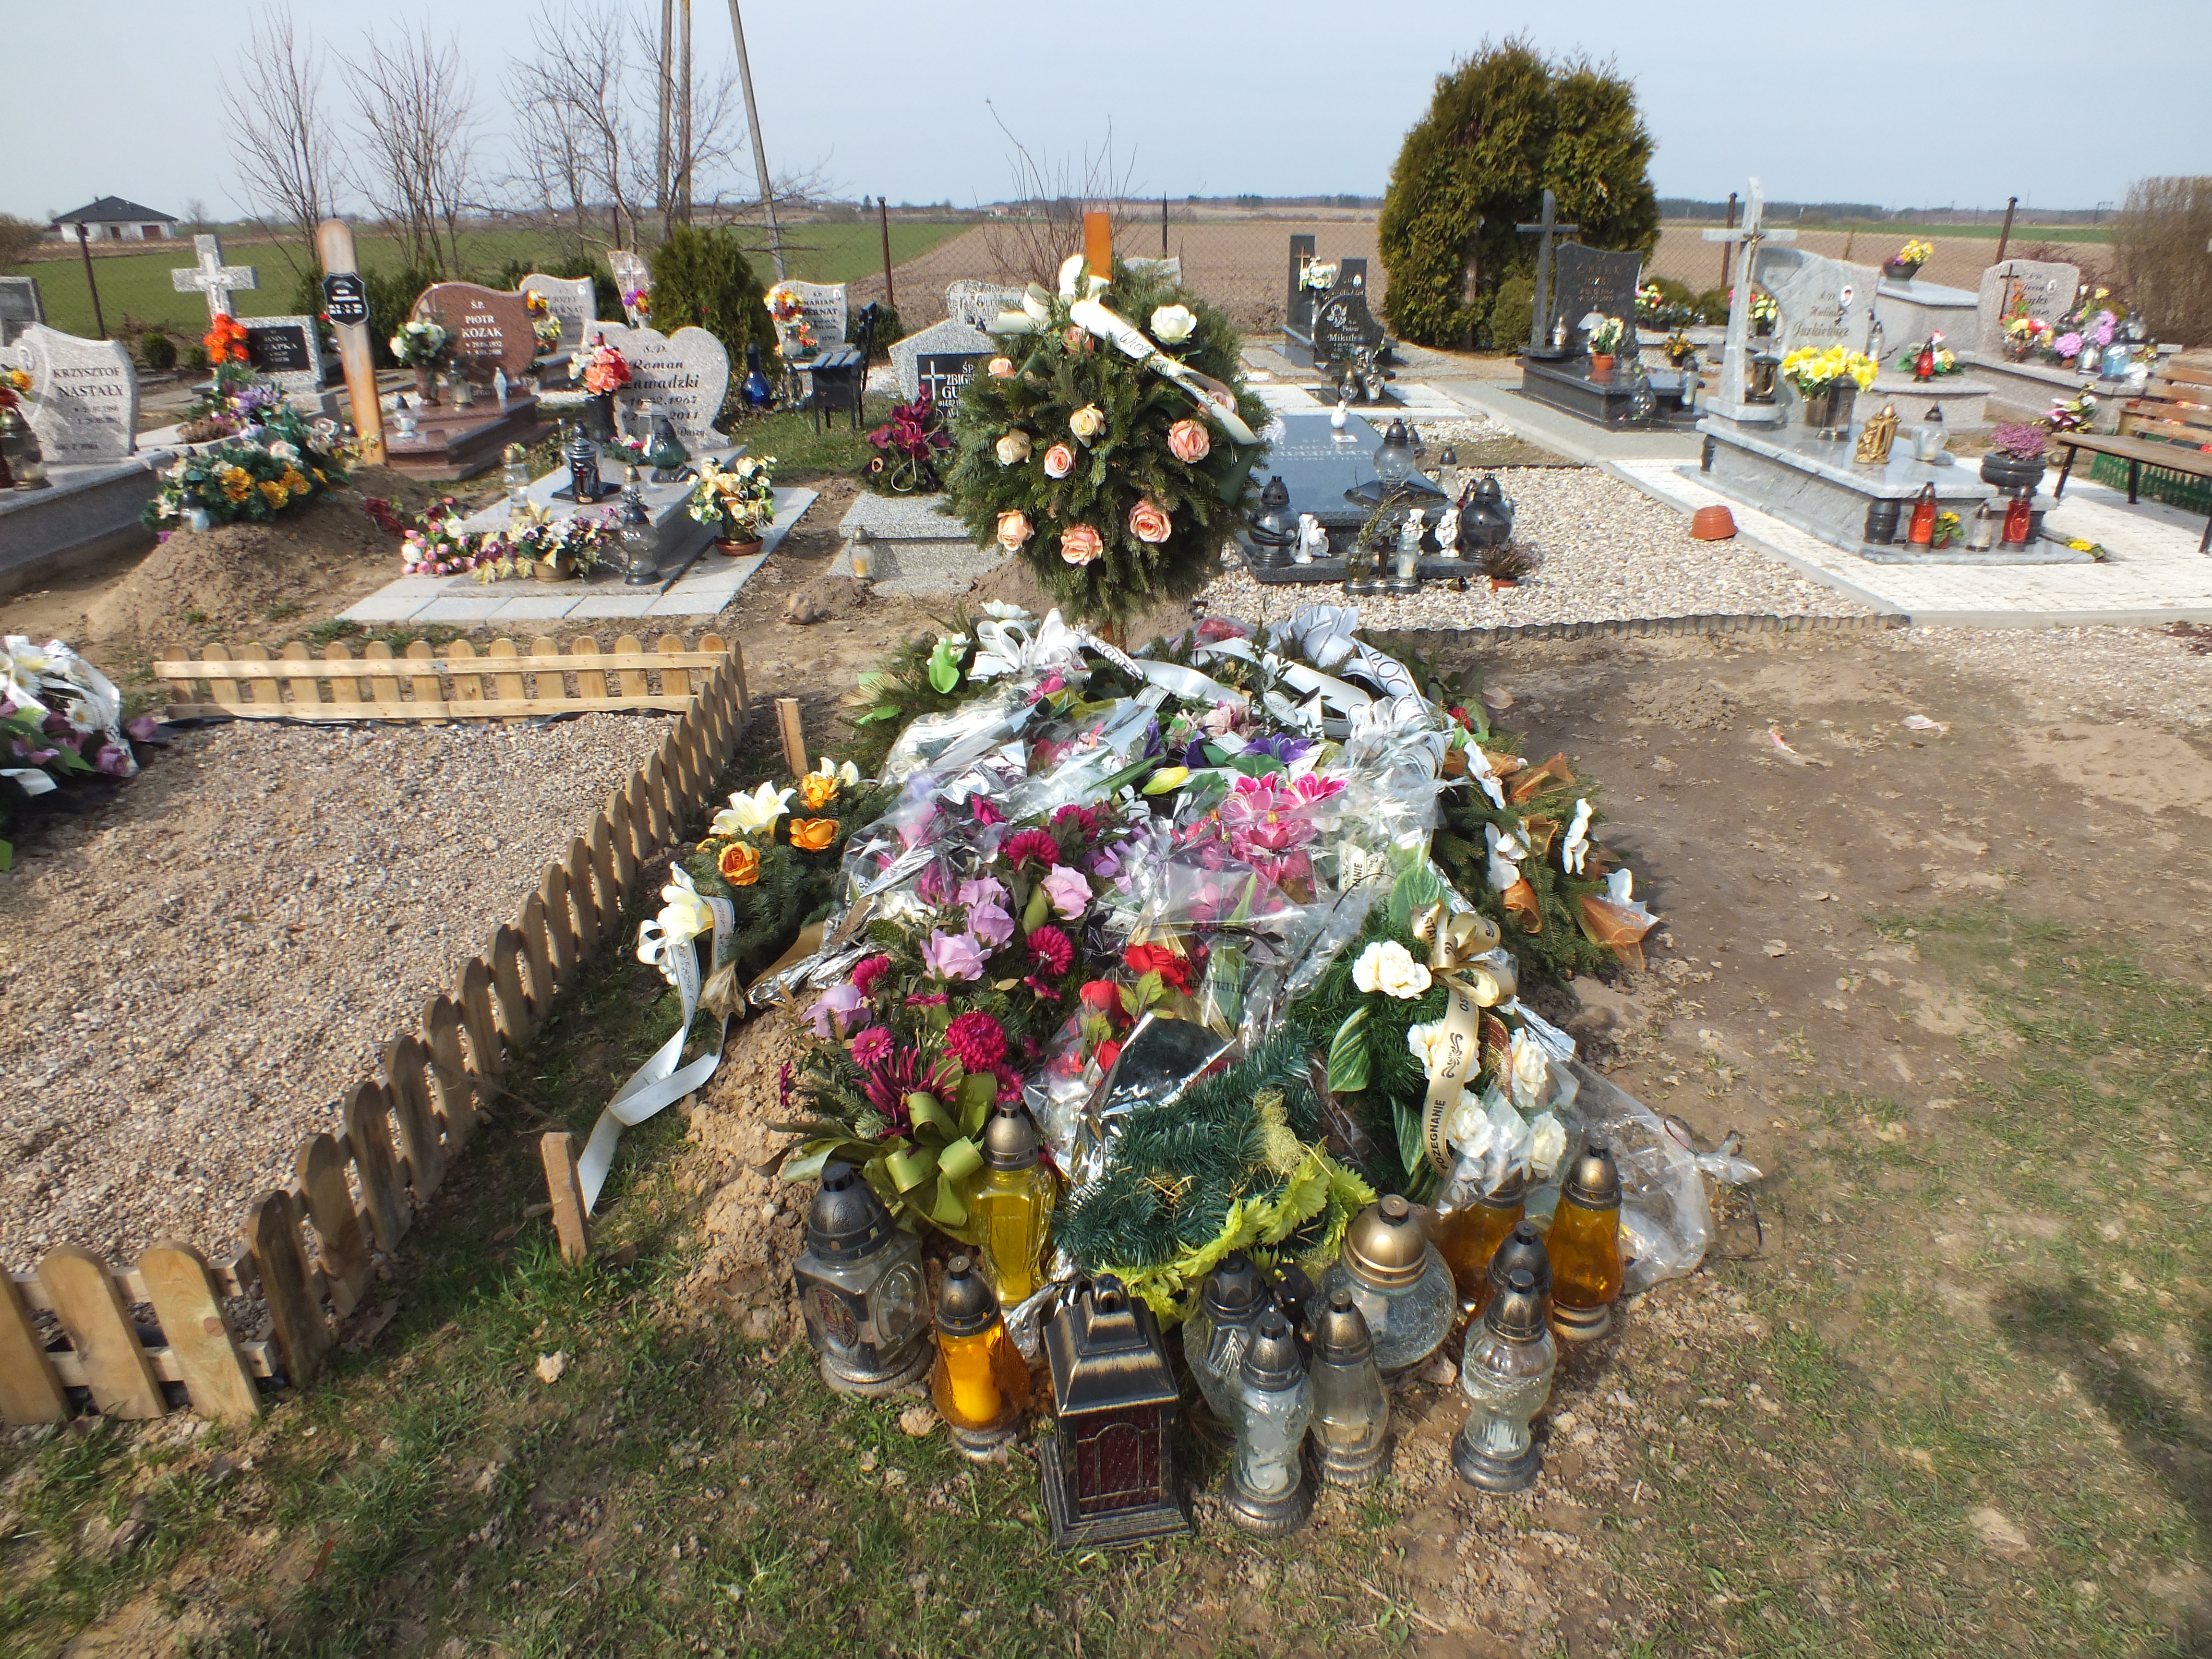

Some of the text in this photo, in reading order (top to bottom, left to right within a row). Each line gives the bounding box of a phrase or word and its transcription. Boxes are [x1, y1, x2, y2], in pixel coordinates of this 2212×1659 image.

[465, 315, 495, 324] PIOTR
[461, 327, 503, 338] KOZAK
[630, 359, 684, 370] Roman
[52, 367, 120, 378] KRZYSZTOF
[946, 374, 975, 386] ZBIGN
[1430, 1099, 1449, 1170] POŻEGNANIE
